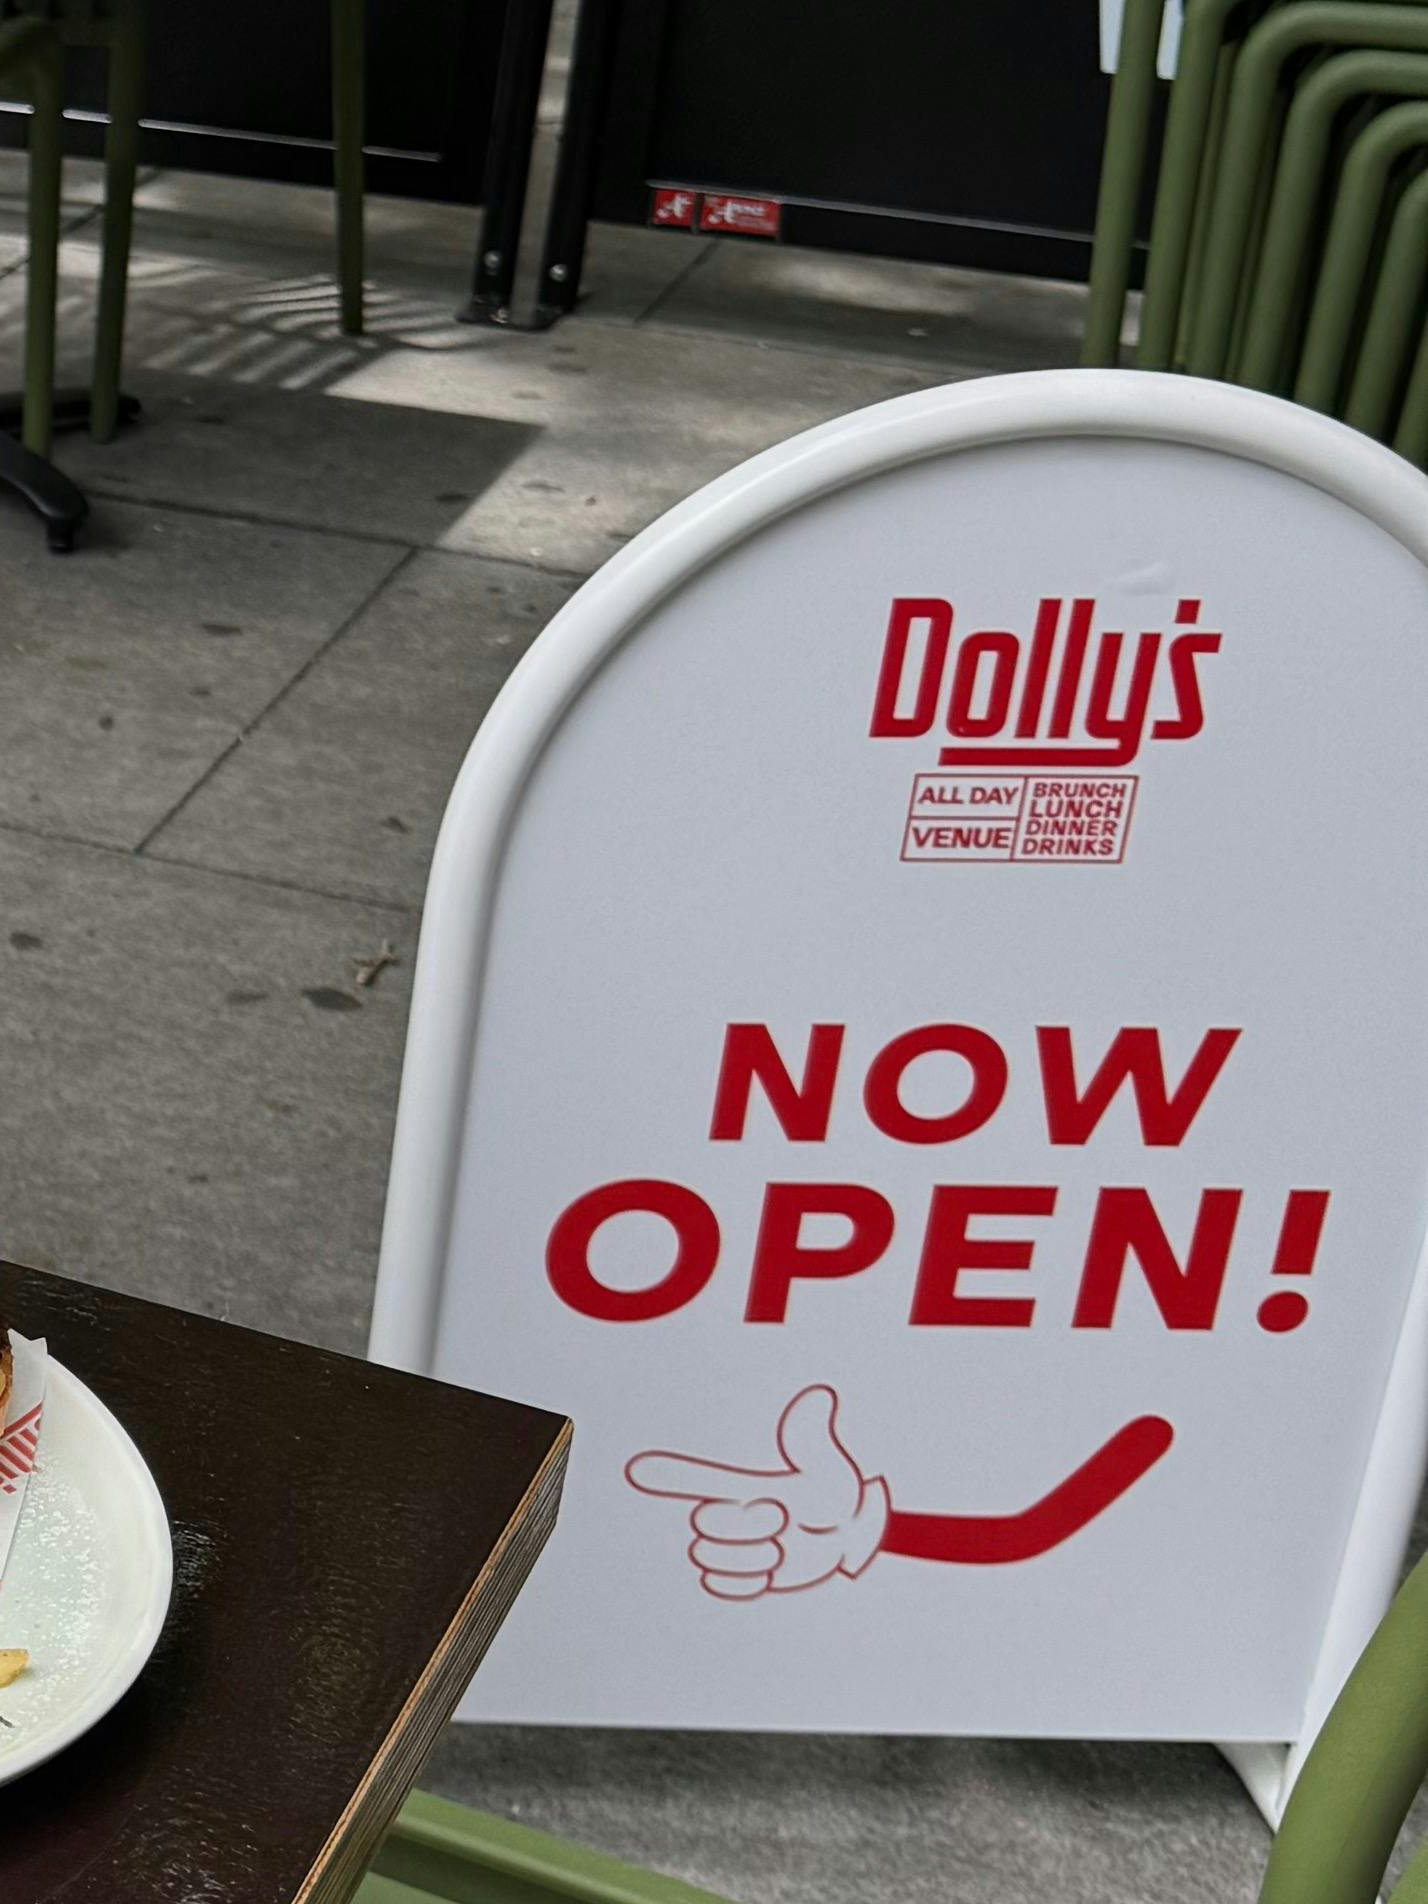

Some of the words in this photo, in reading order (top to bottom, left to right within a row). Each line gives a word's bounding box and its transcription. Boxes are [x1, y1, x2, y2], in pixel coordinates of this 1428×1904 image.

[869, 598, 1223, 768] Dolly's
[917, 786, 964, 806] ALL
[969, 786, 1020, 806] DAY
[1032, 782, 1128, 799] BRUNCH
[1028, 800, 1123, 819] LUNCH
[912, 827, 1012, 849] VENUE
[1024, 820, 1118, 837] DINNER
[1020, 838, 1114, 856] DRINKS
[708, 1022, 1243, 1147] NOW
[544, 1178, 1330, 1332] OPEN!
